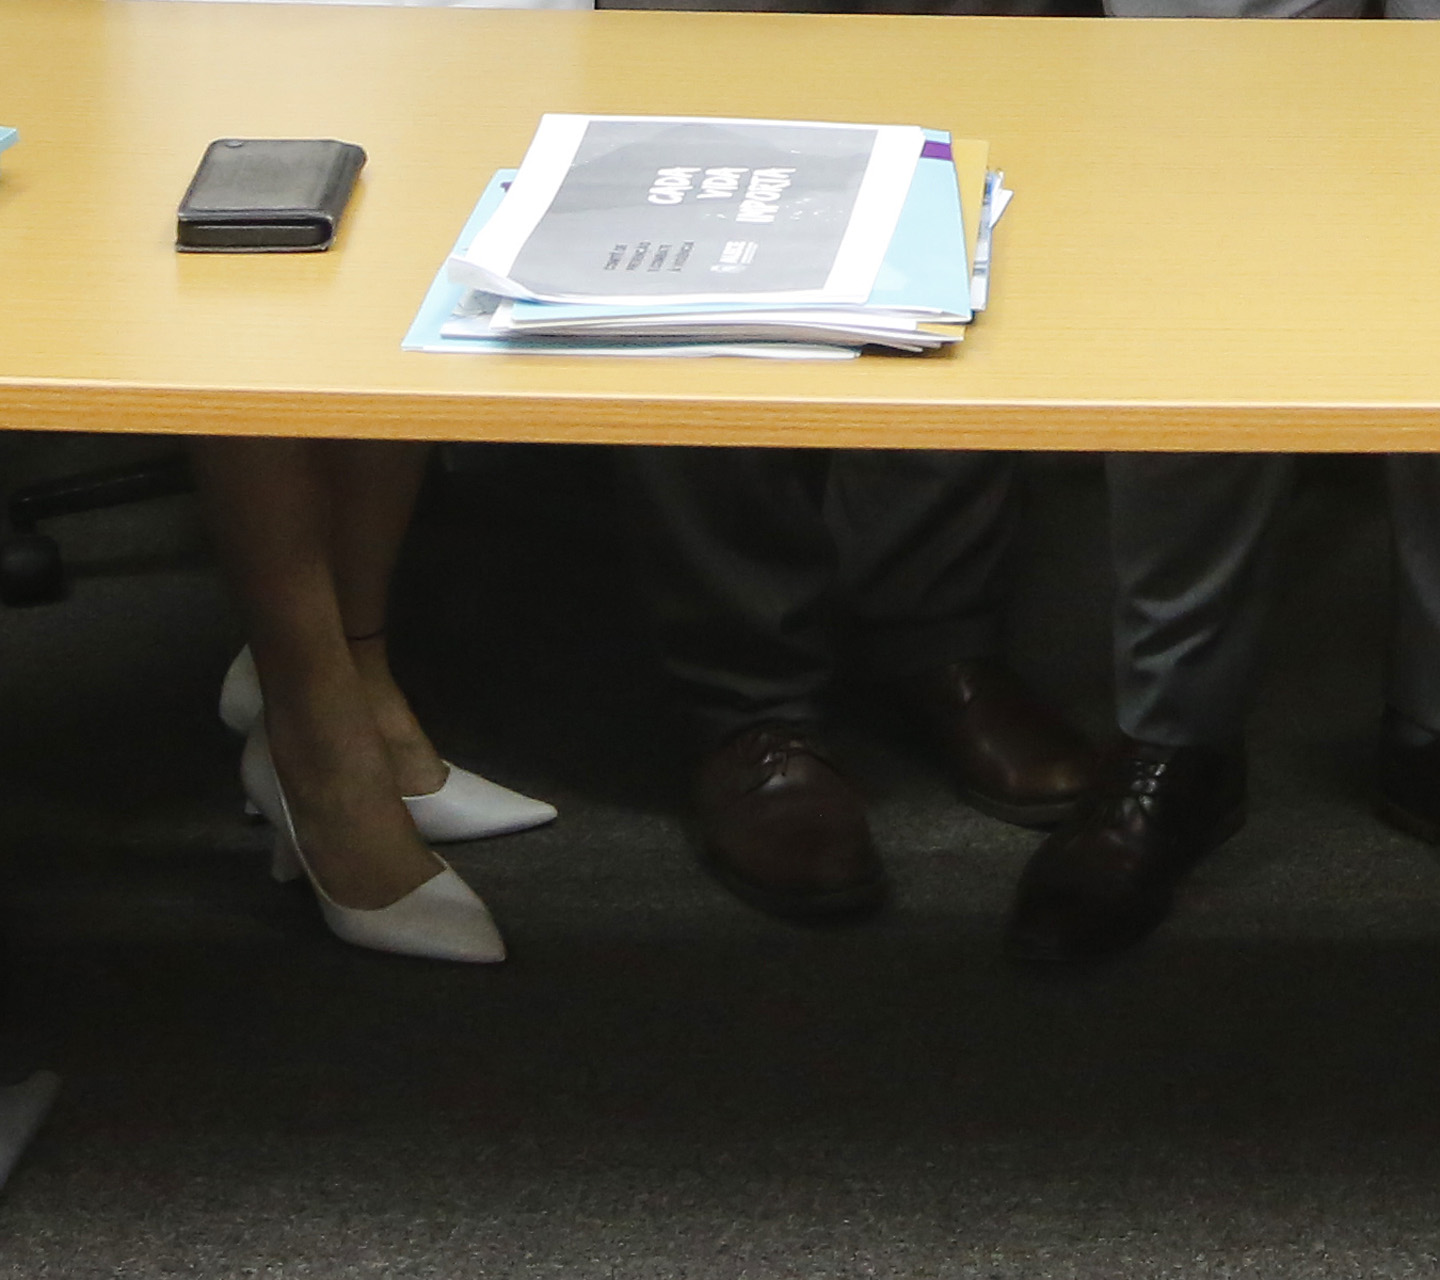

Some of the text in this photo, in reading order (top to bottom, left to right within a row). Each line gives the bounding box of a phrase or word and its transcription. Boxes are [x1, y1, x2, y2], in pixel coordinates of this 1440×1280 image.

[647, 167, 702, 205] CADA
[696, 167, 750, 199] VIDA
[735, 167, 797, 223] IMPORTA
